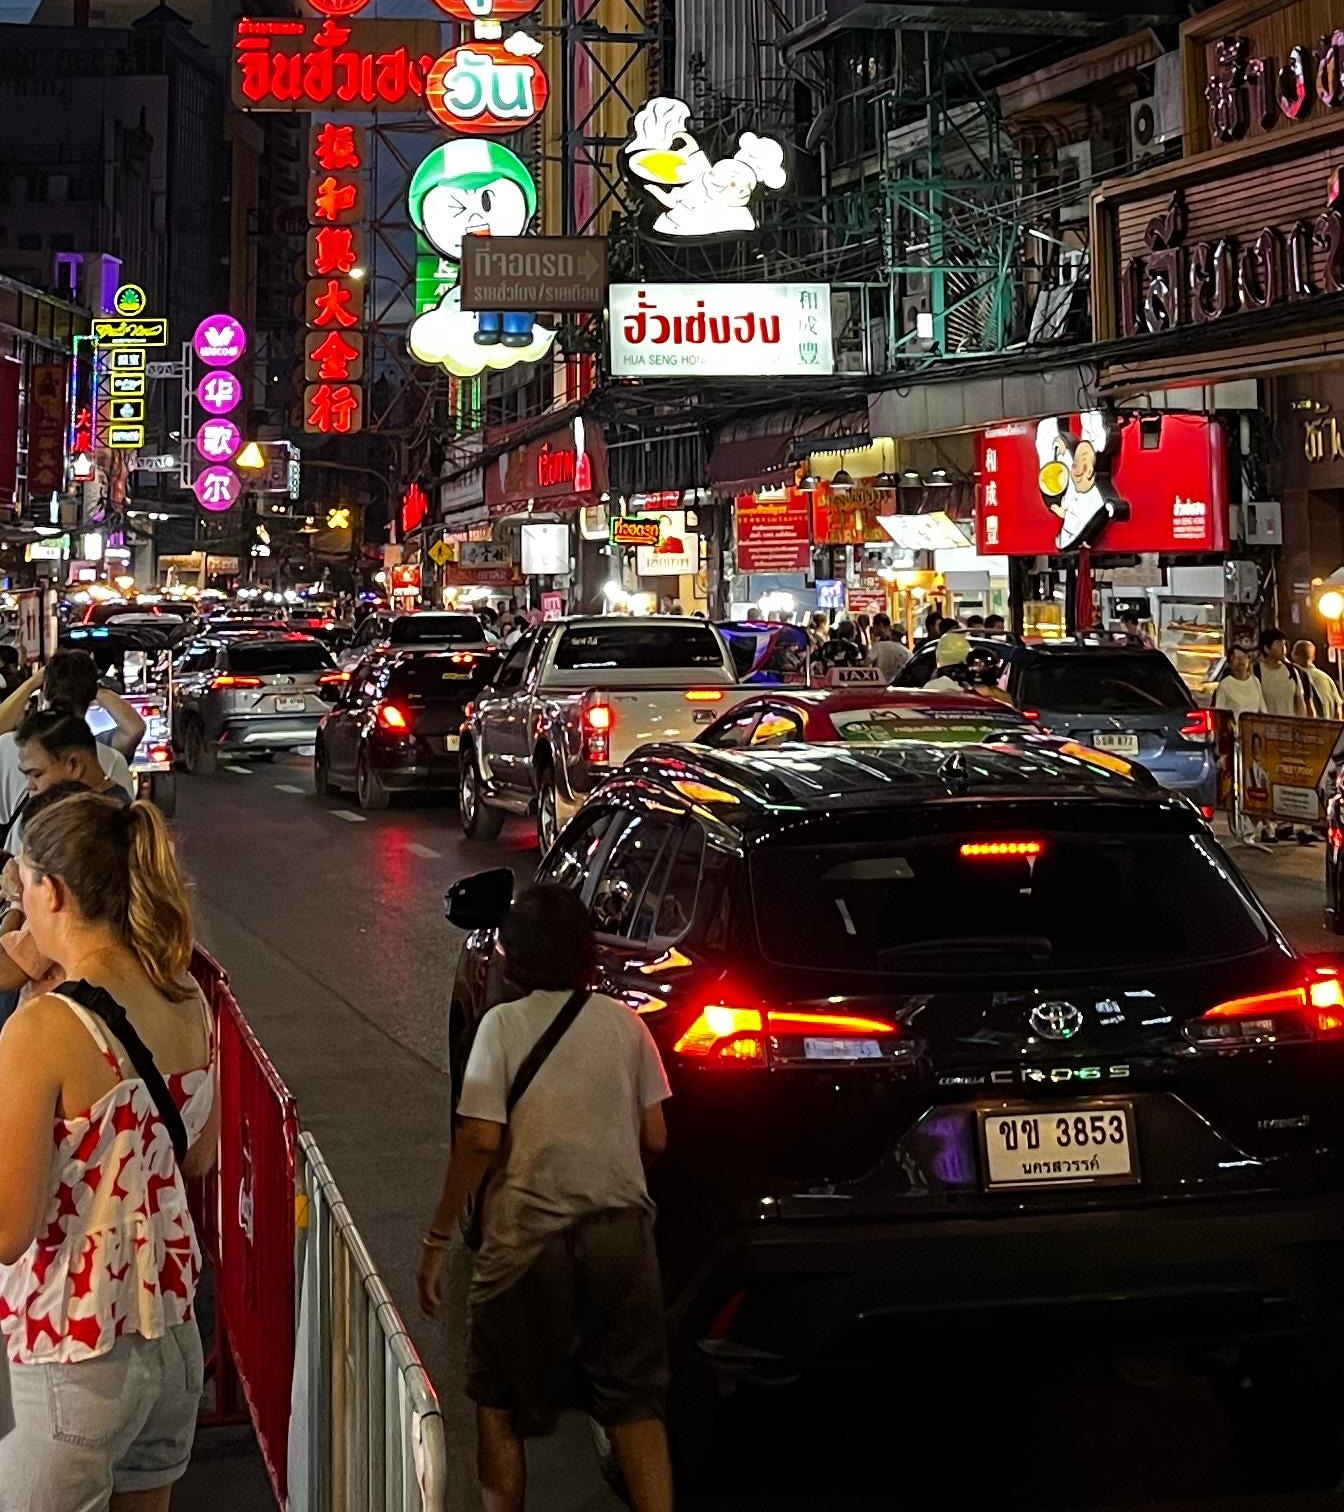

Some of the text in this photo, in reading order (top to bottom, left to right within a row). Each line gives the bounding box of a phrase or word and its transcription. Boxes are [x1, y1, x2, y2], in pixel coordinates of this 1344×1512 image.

[448, 46, 529, 118] วัน
[474, 241, 574, 277] ที่จอดรถ
[623, 290, 782, 345] ฮั่วเซ่งฮง
[623, 354, 646, 366] HUA
[648, 354, 678, 366] SENG
[839, 669, 880, 682] TAXI
[990, 1064, 1131, 1084] CROSS
[1056, 1115, 1125, 1148] 3853
